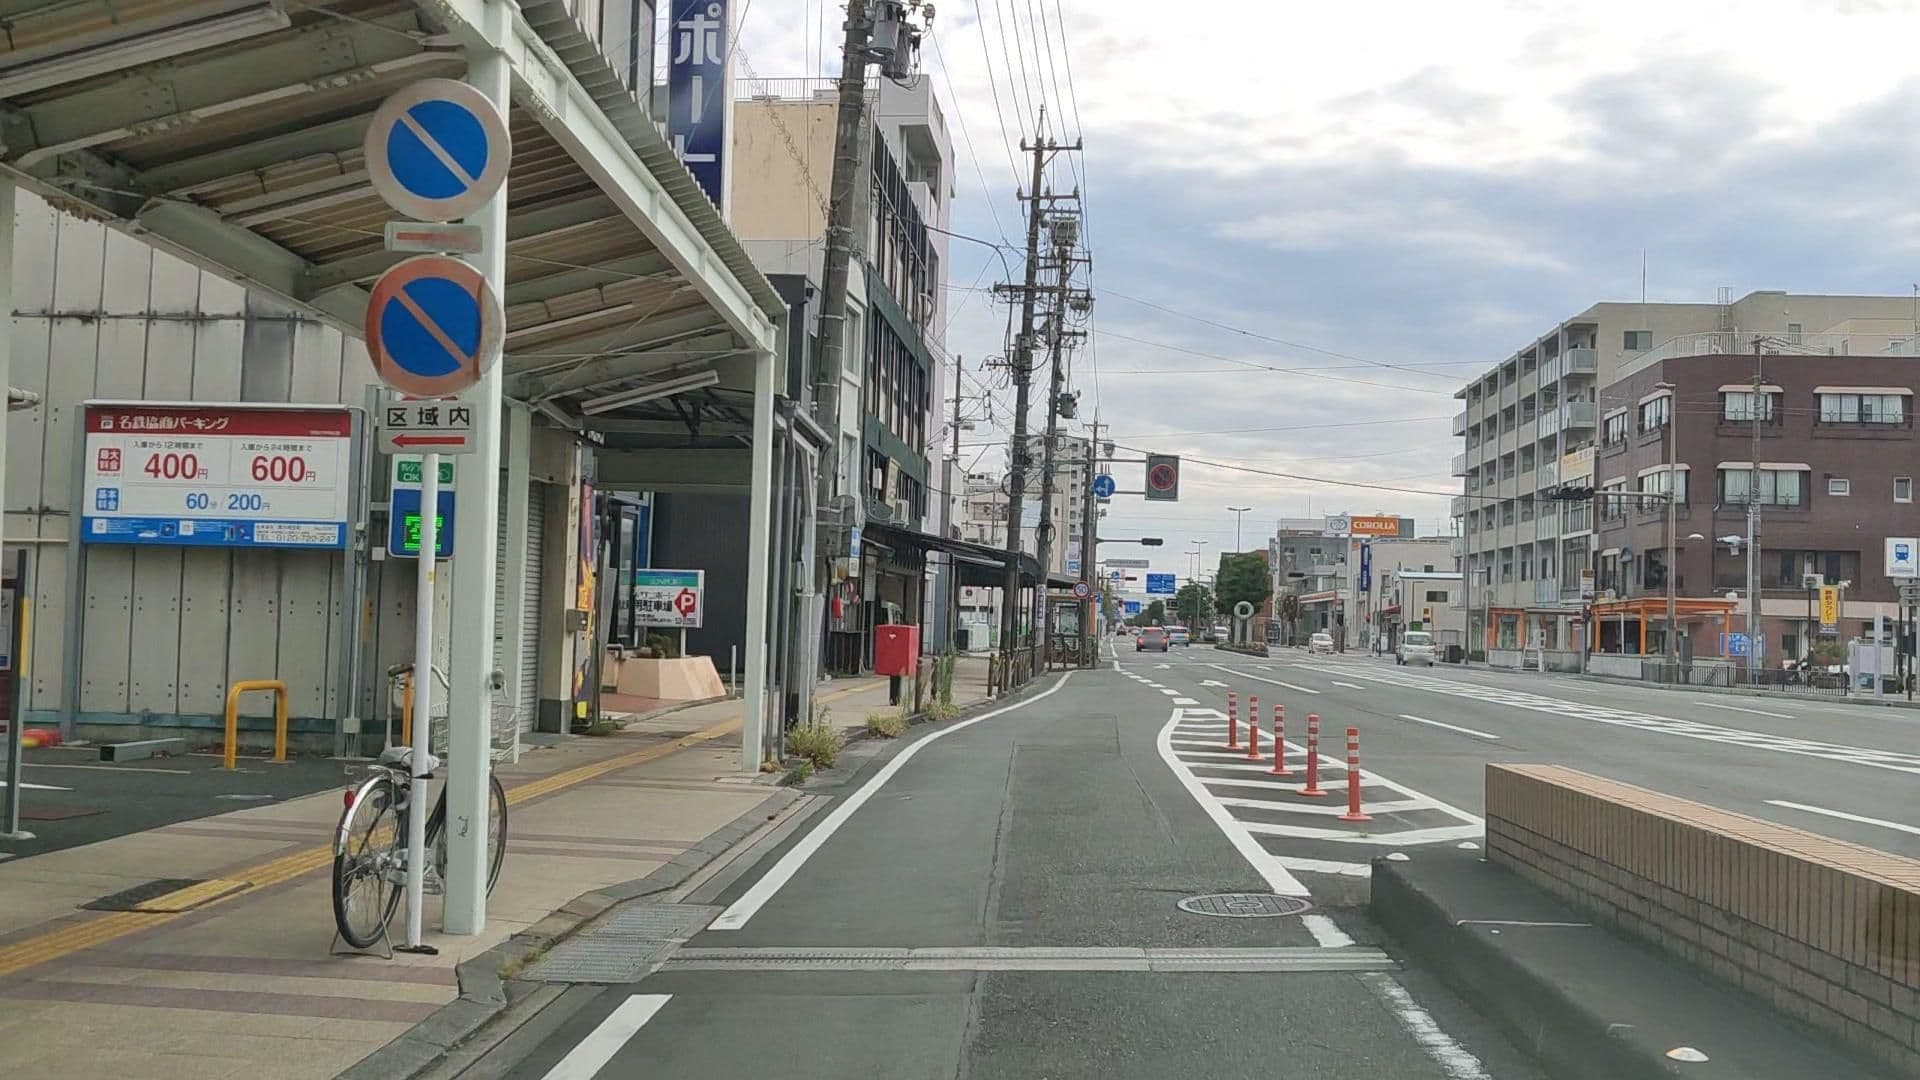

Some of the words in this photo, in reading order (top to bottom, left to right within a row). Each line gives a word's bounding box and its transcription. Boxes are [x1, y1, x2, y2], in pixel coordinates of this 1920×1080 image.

[119, 415, 229, 430] 名鉄協商パーキング
[386, 407, 470, 427] 区域内
[144, 452, 208, 480] 400円
[251, 455, 316, 482] 600円
[1353, 521, 1395, 530] COROLLA
[1076, 585, 1088, 594] 50
